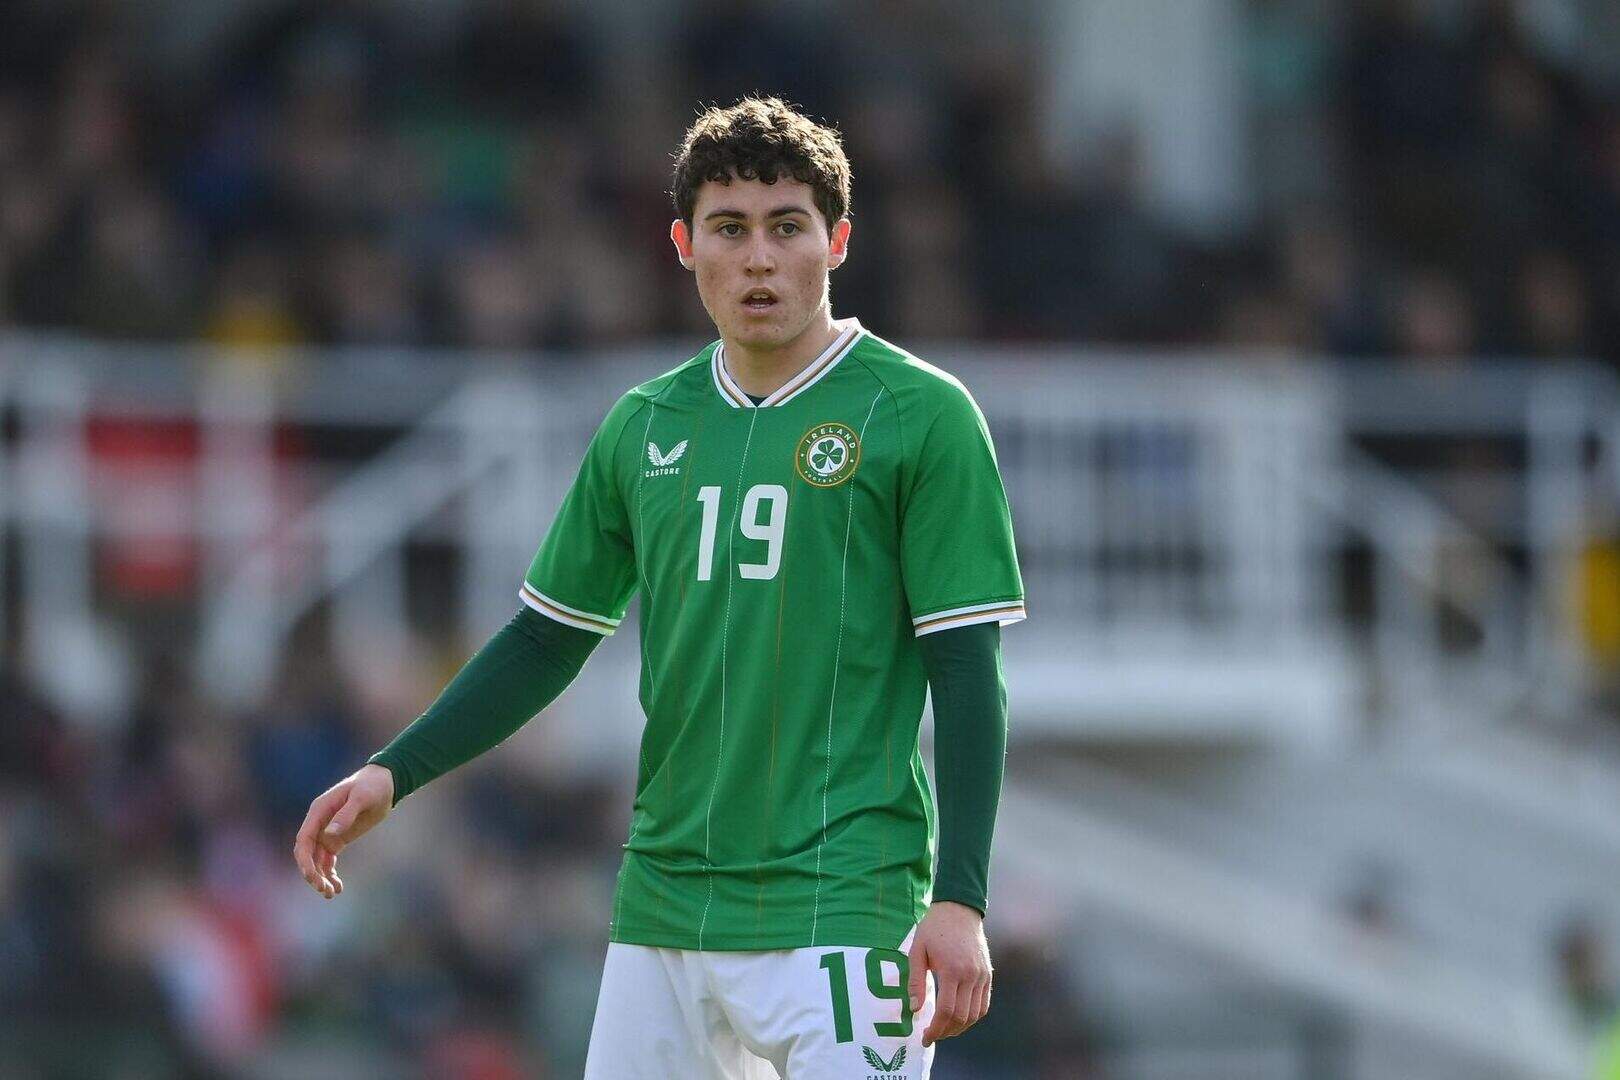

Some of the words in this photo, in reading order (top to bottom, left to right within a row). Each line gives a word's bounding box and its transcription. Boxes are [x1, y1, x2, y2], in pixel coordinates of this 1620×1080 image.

[805, 426, 857, 449] IRELAND
[645, 467, 680, 478] CASTORE
[696, 484, 789, 581] 19
[819, 947, 914, 1044] 19
